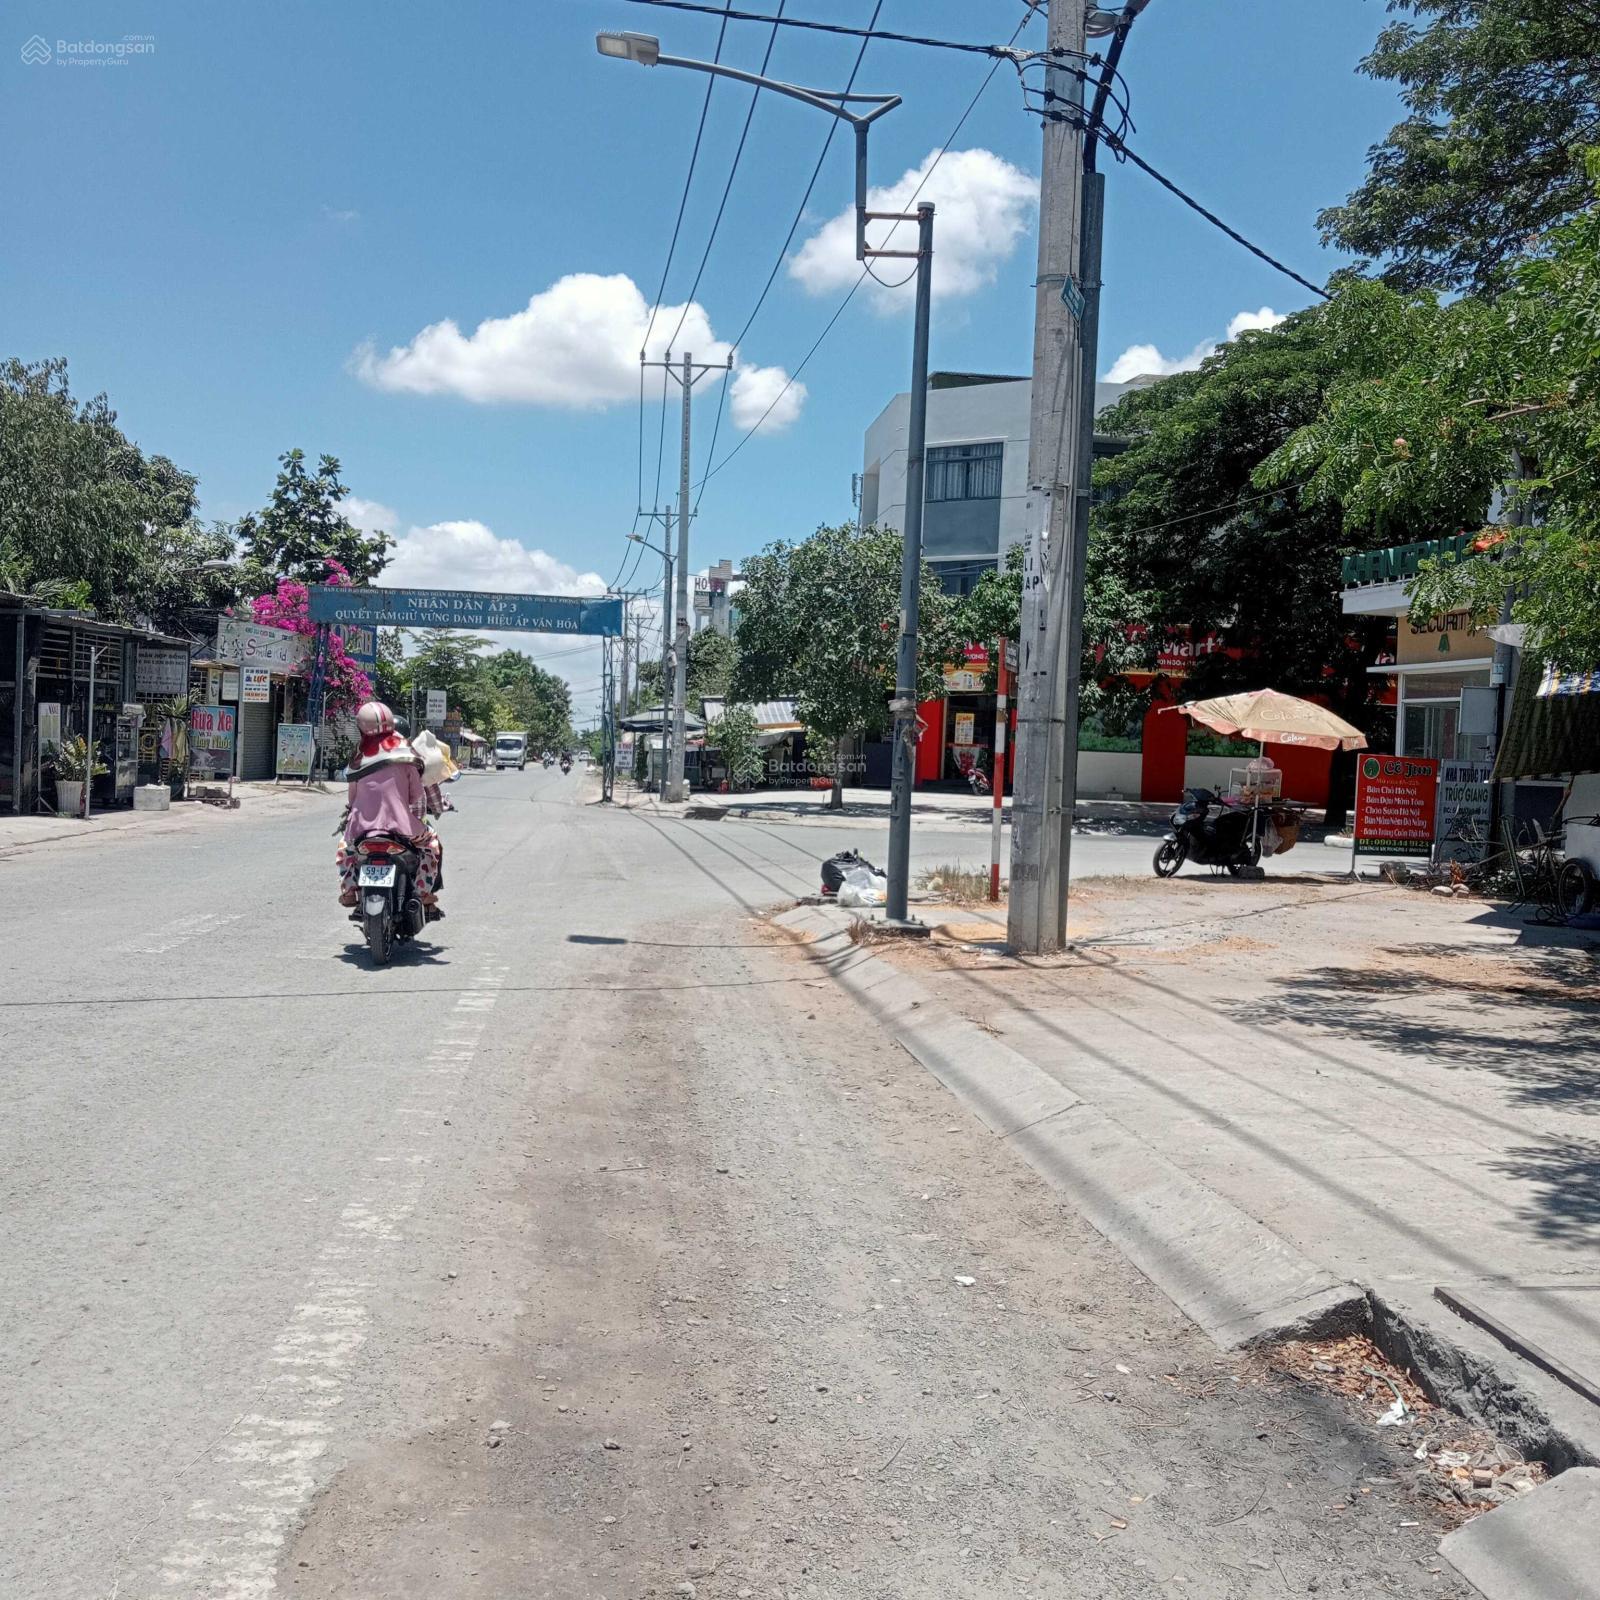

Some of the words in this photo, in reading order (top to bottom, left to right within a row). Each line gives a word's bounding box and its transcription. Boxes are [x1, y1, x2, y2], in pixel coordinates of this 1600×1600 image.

[408, 596, 449, 609] NHÂN
[453, 598, 483, 611] DÂN
[488, 598, 507, 613] ẤP
[509, 604, 517, 613] 3
[335, 605, 371, 620] QUYẾT
[420, 607, 450, 622] VỮNG
[453, 613, 483, 624] DANH
[487, 614, 513, 628] HIỆU
[515, 613, 529, 627] ẤP
[217, 710, 232, 732] Xe
[1405, 787, 1417, 797] Nội
[1445, 783, 1463, 801] TRÚC
[1465, 787, 1489, 802] GIANG
